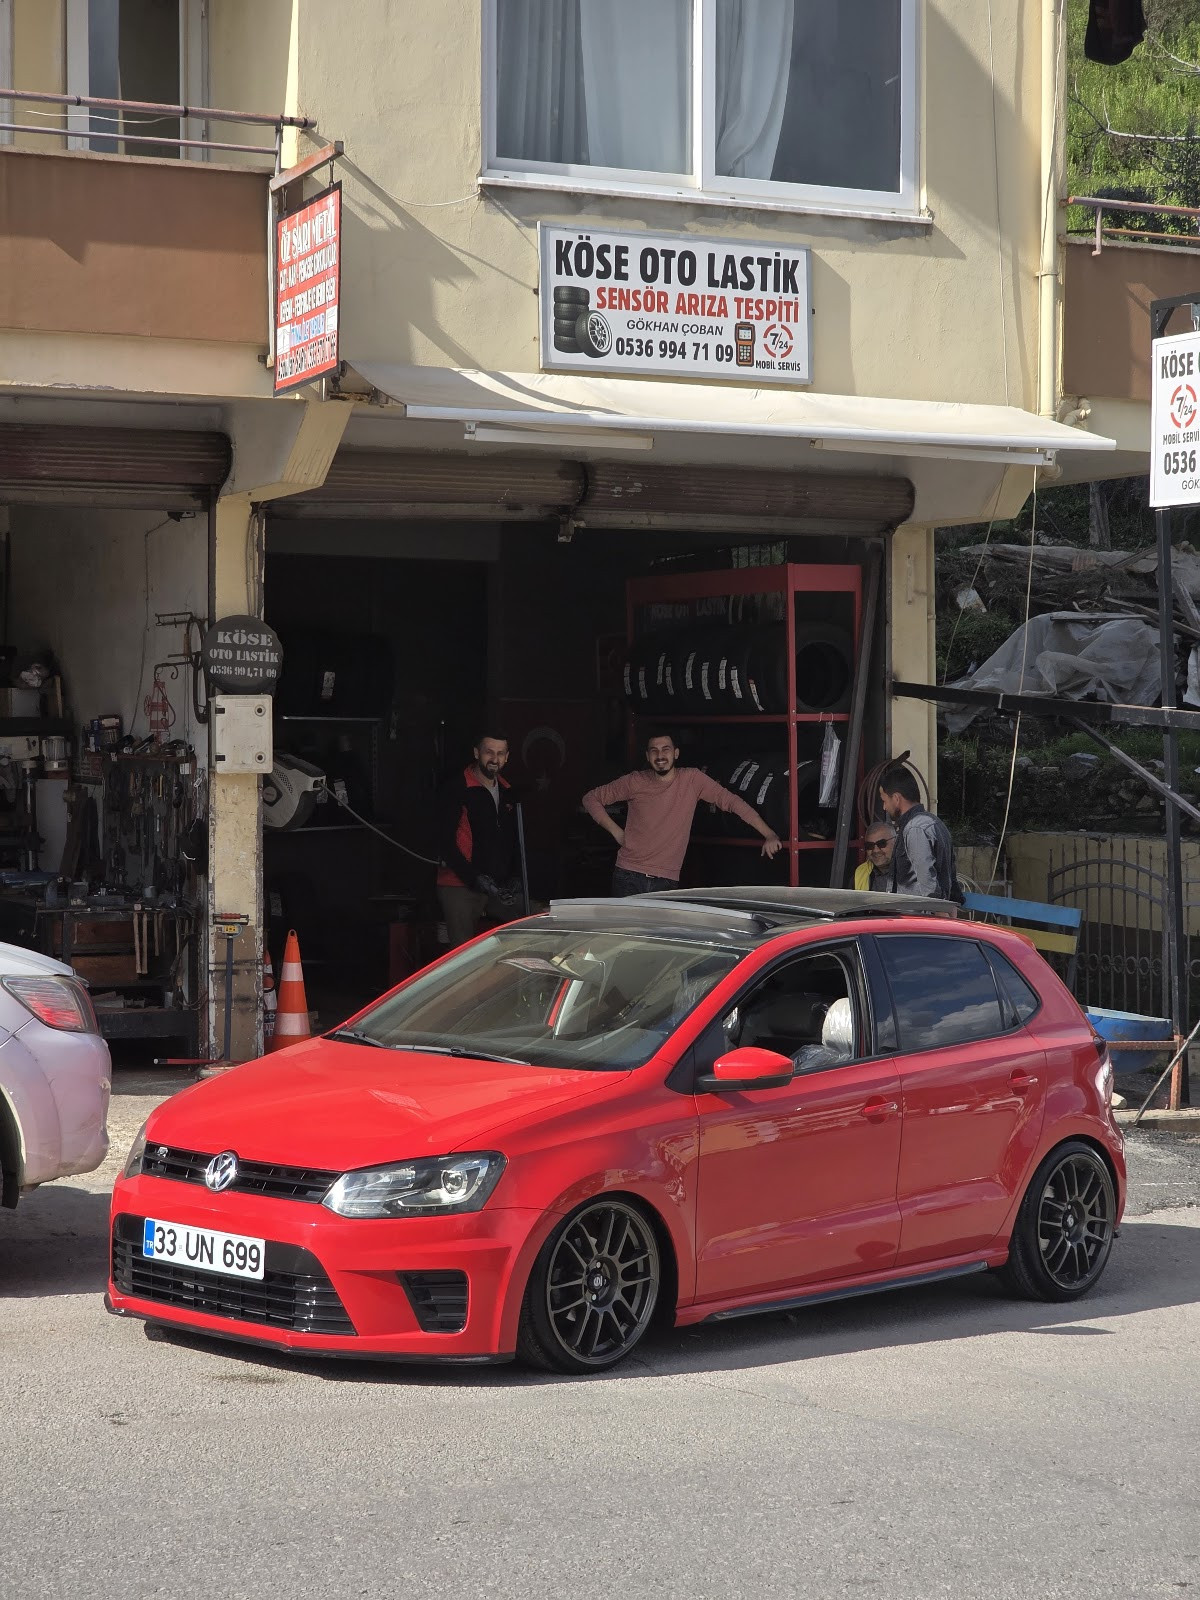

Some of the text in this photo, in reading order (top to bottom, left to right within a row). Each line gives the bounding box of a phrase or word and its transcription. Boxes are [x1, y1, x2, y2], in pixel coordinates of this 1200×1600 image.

[555, 234, 799, 294] KÖSE OTO LASTİK
[596, 286, 799, 323] SENSÖR ARIZA TESPİTİ
[626, 318, 723, 337] GÖKHAN ÇOBAN
[616, 337, 733, 362] 0536 994 71 09
[770, 332, 788, 351] 7/24
[756, 359, 801, 372] MOBİL SERVİS
[1161, 350, 1194, 379] KÖSE
[1176, 395, 1192, 418] 7/24
[1163, 432, 1180, 446] MOBİL
[1164, 450, 1196, 475] 0536
[217, 629, 272, 647] KÖSE
[209, 648, 278, 663] OTO LASTİK
[210, 665, 232, 675] 0536
[266, 668, 276, 678] 09
[146, 1240, 154, 1249] TR
[154, 1227, 261, 1272] 33 UN 699
